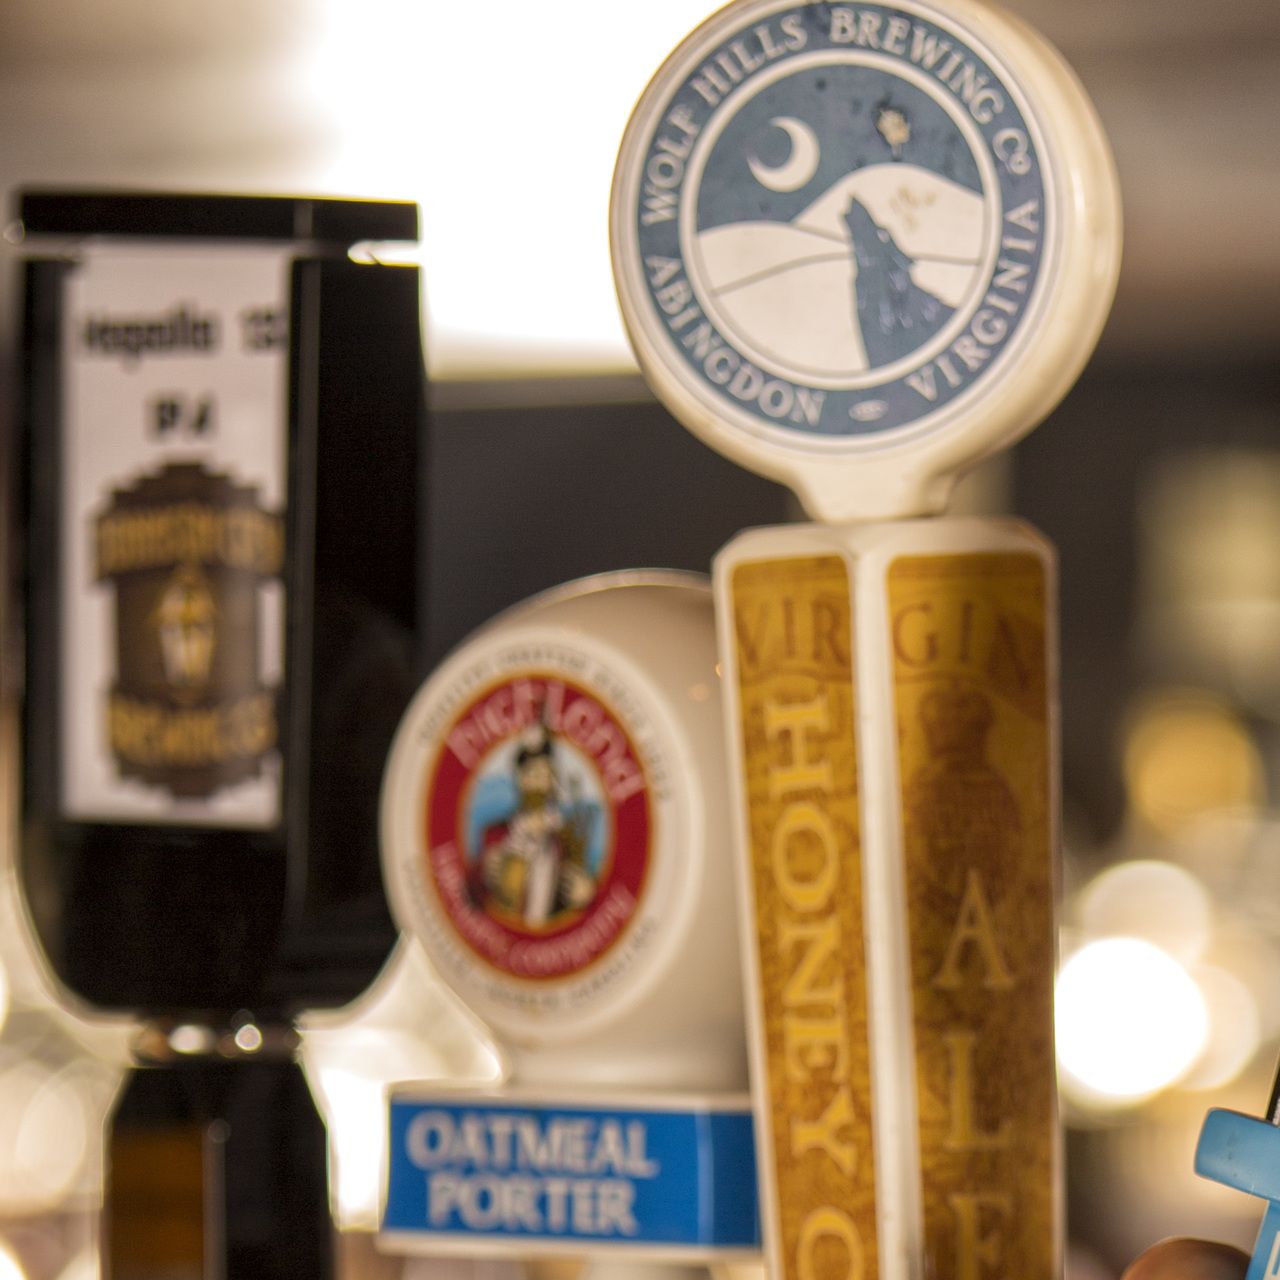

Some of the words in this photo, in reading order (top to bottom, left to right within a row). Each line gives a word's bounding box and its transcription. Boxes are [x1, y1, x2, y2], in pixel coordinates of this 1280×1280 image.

[641, 104, 700, 227] WOLF
[690, 14, 808, 109] HILLS
[828, 8, 1004, 126] BREWING
[645, 254, 826, 427] ABINGDON
[904, 198, 1041, 403] VIRGINIA
[763, 692, 858, 1179] HONEY
[405, 1107, 660, 1181] OATMEAL
[427, 1172, 641, 1238] PORTER
